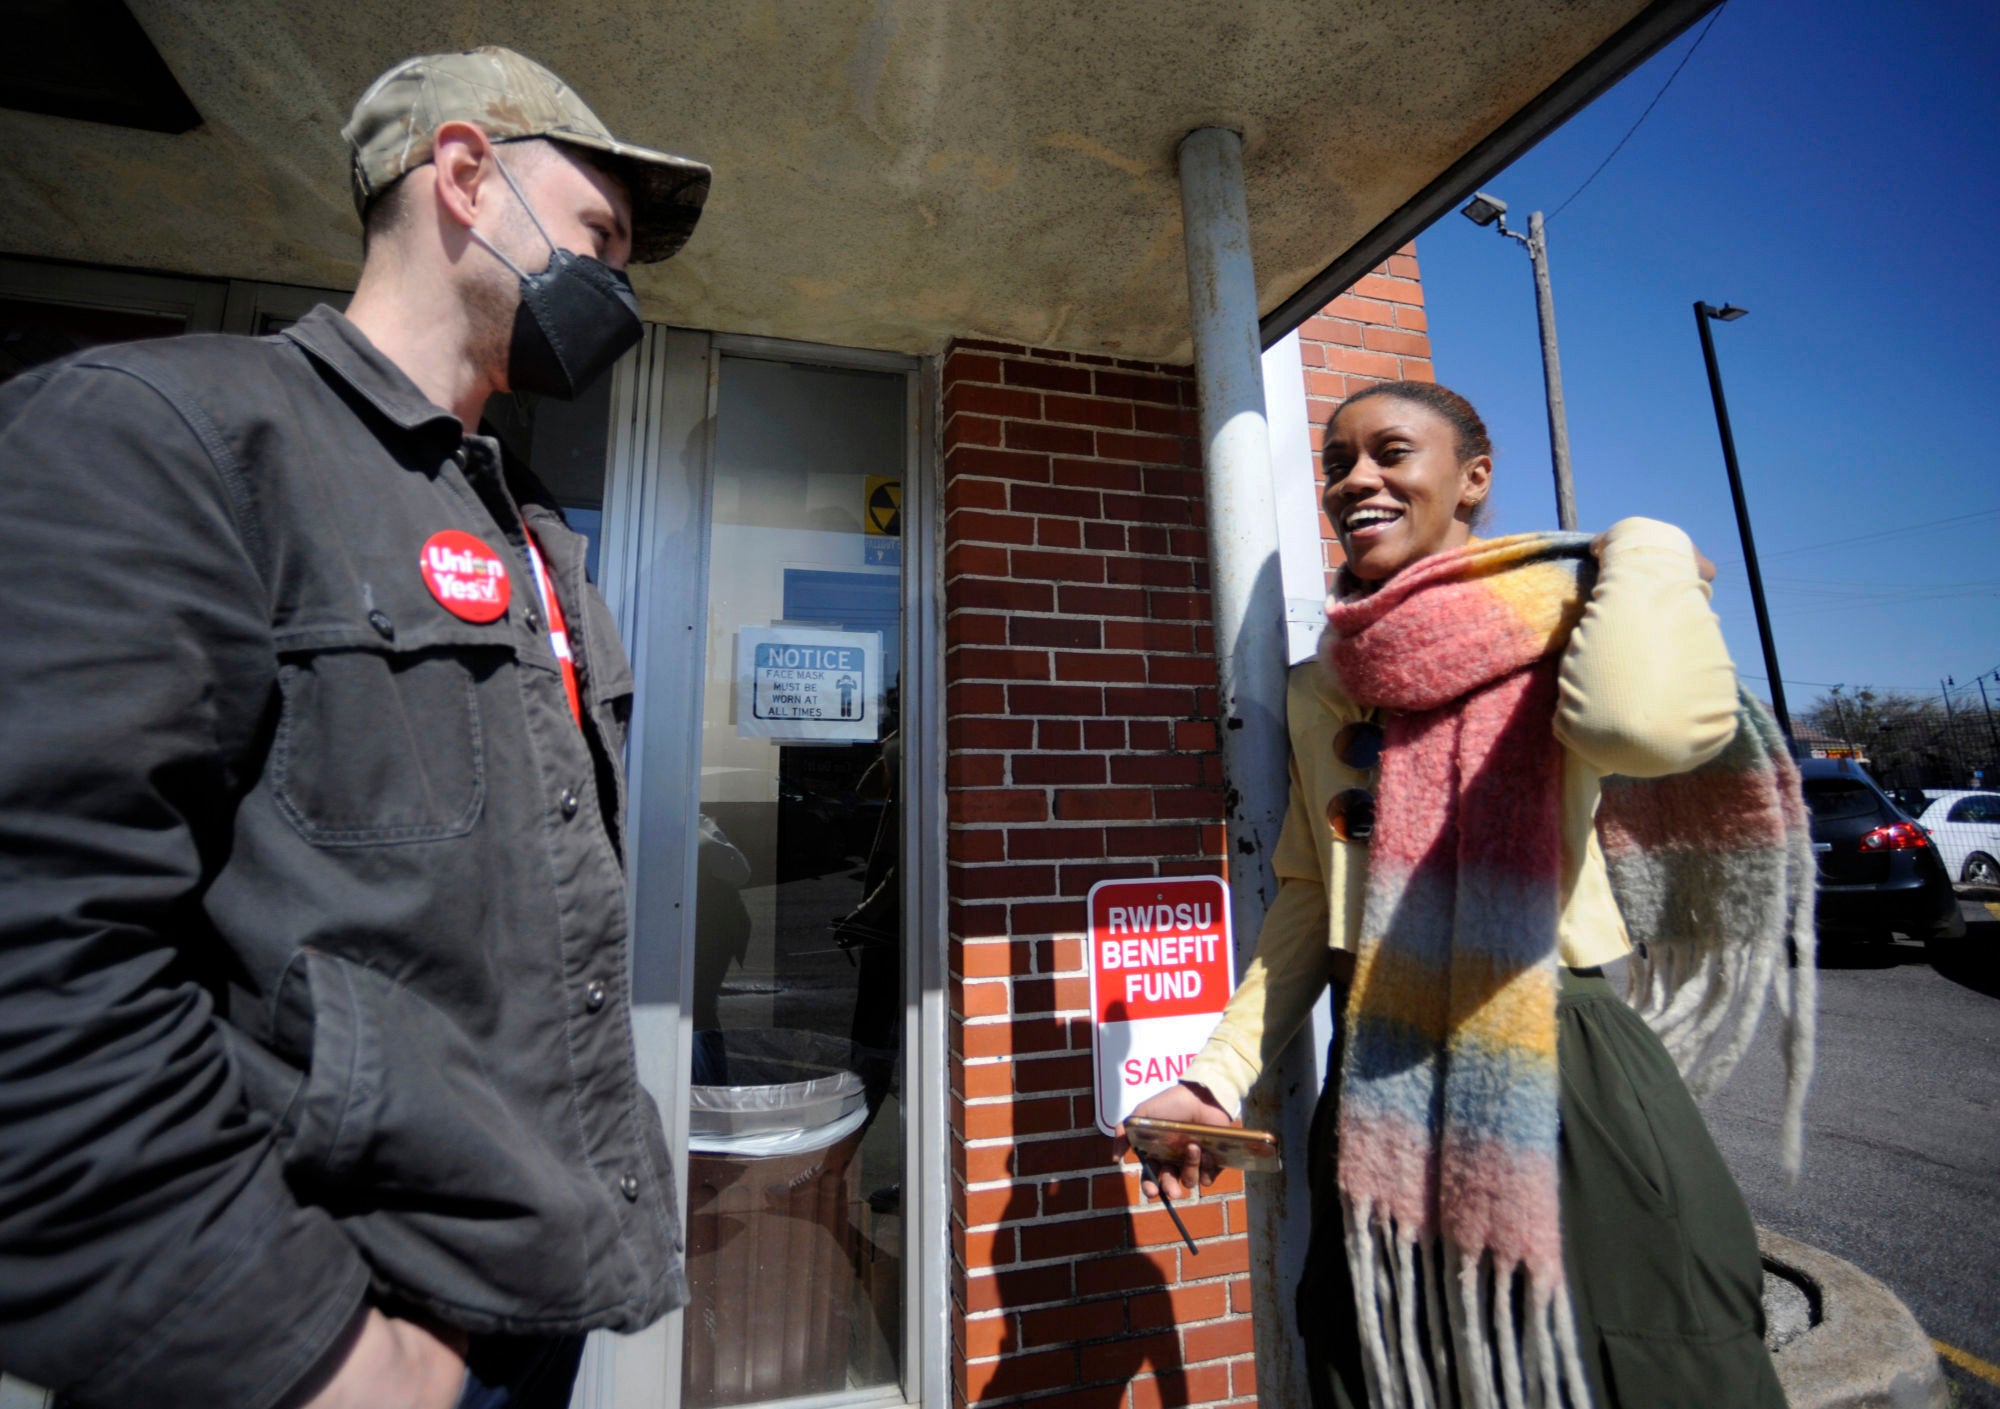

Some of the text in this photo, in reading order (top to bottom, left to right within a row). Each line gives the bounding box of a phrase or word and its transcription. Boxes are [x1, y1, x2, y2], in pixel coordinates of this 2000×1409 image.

[429, 546, 505, 577] Union
[769, 648, 850, 669] NOTICE
[766, 670, 825, 681] FACE MASK
[773, 682, 817, 692] MUST BE
[772, 694, 818, 705] WORN AT
[768, 707, 822, 717] ALL TIMES
[1108, 902, 1212, 935] RWDSU
[1102, 935, 1219, 969] BENEFIT
[1125, 970, 1202, 1003] FUND
